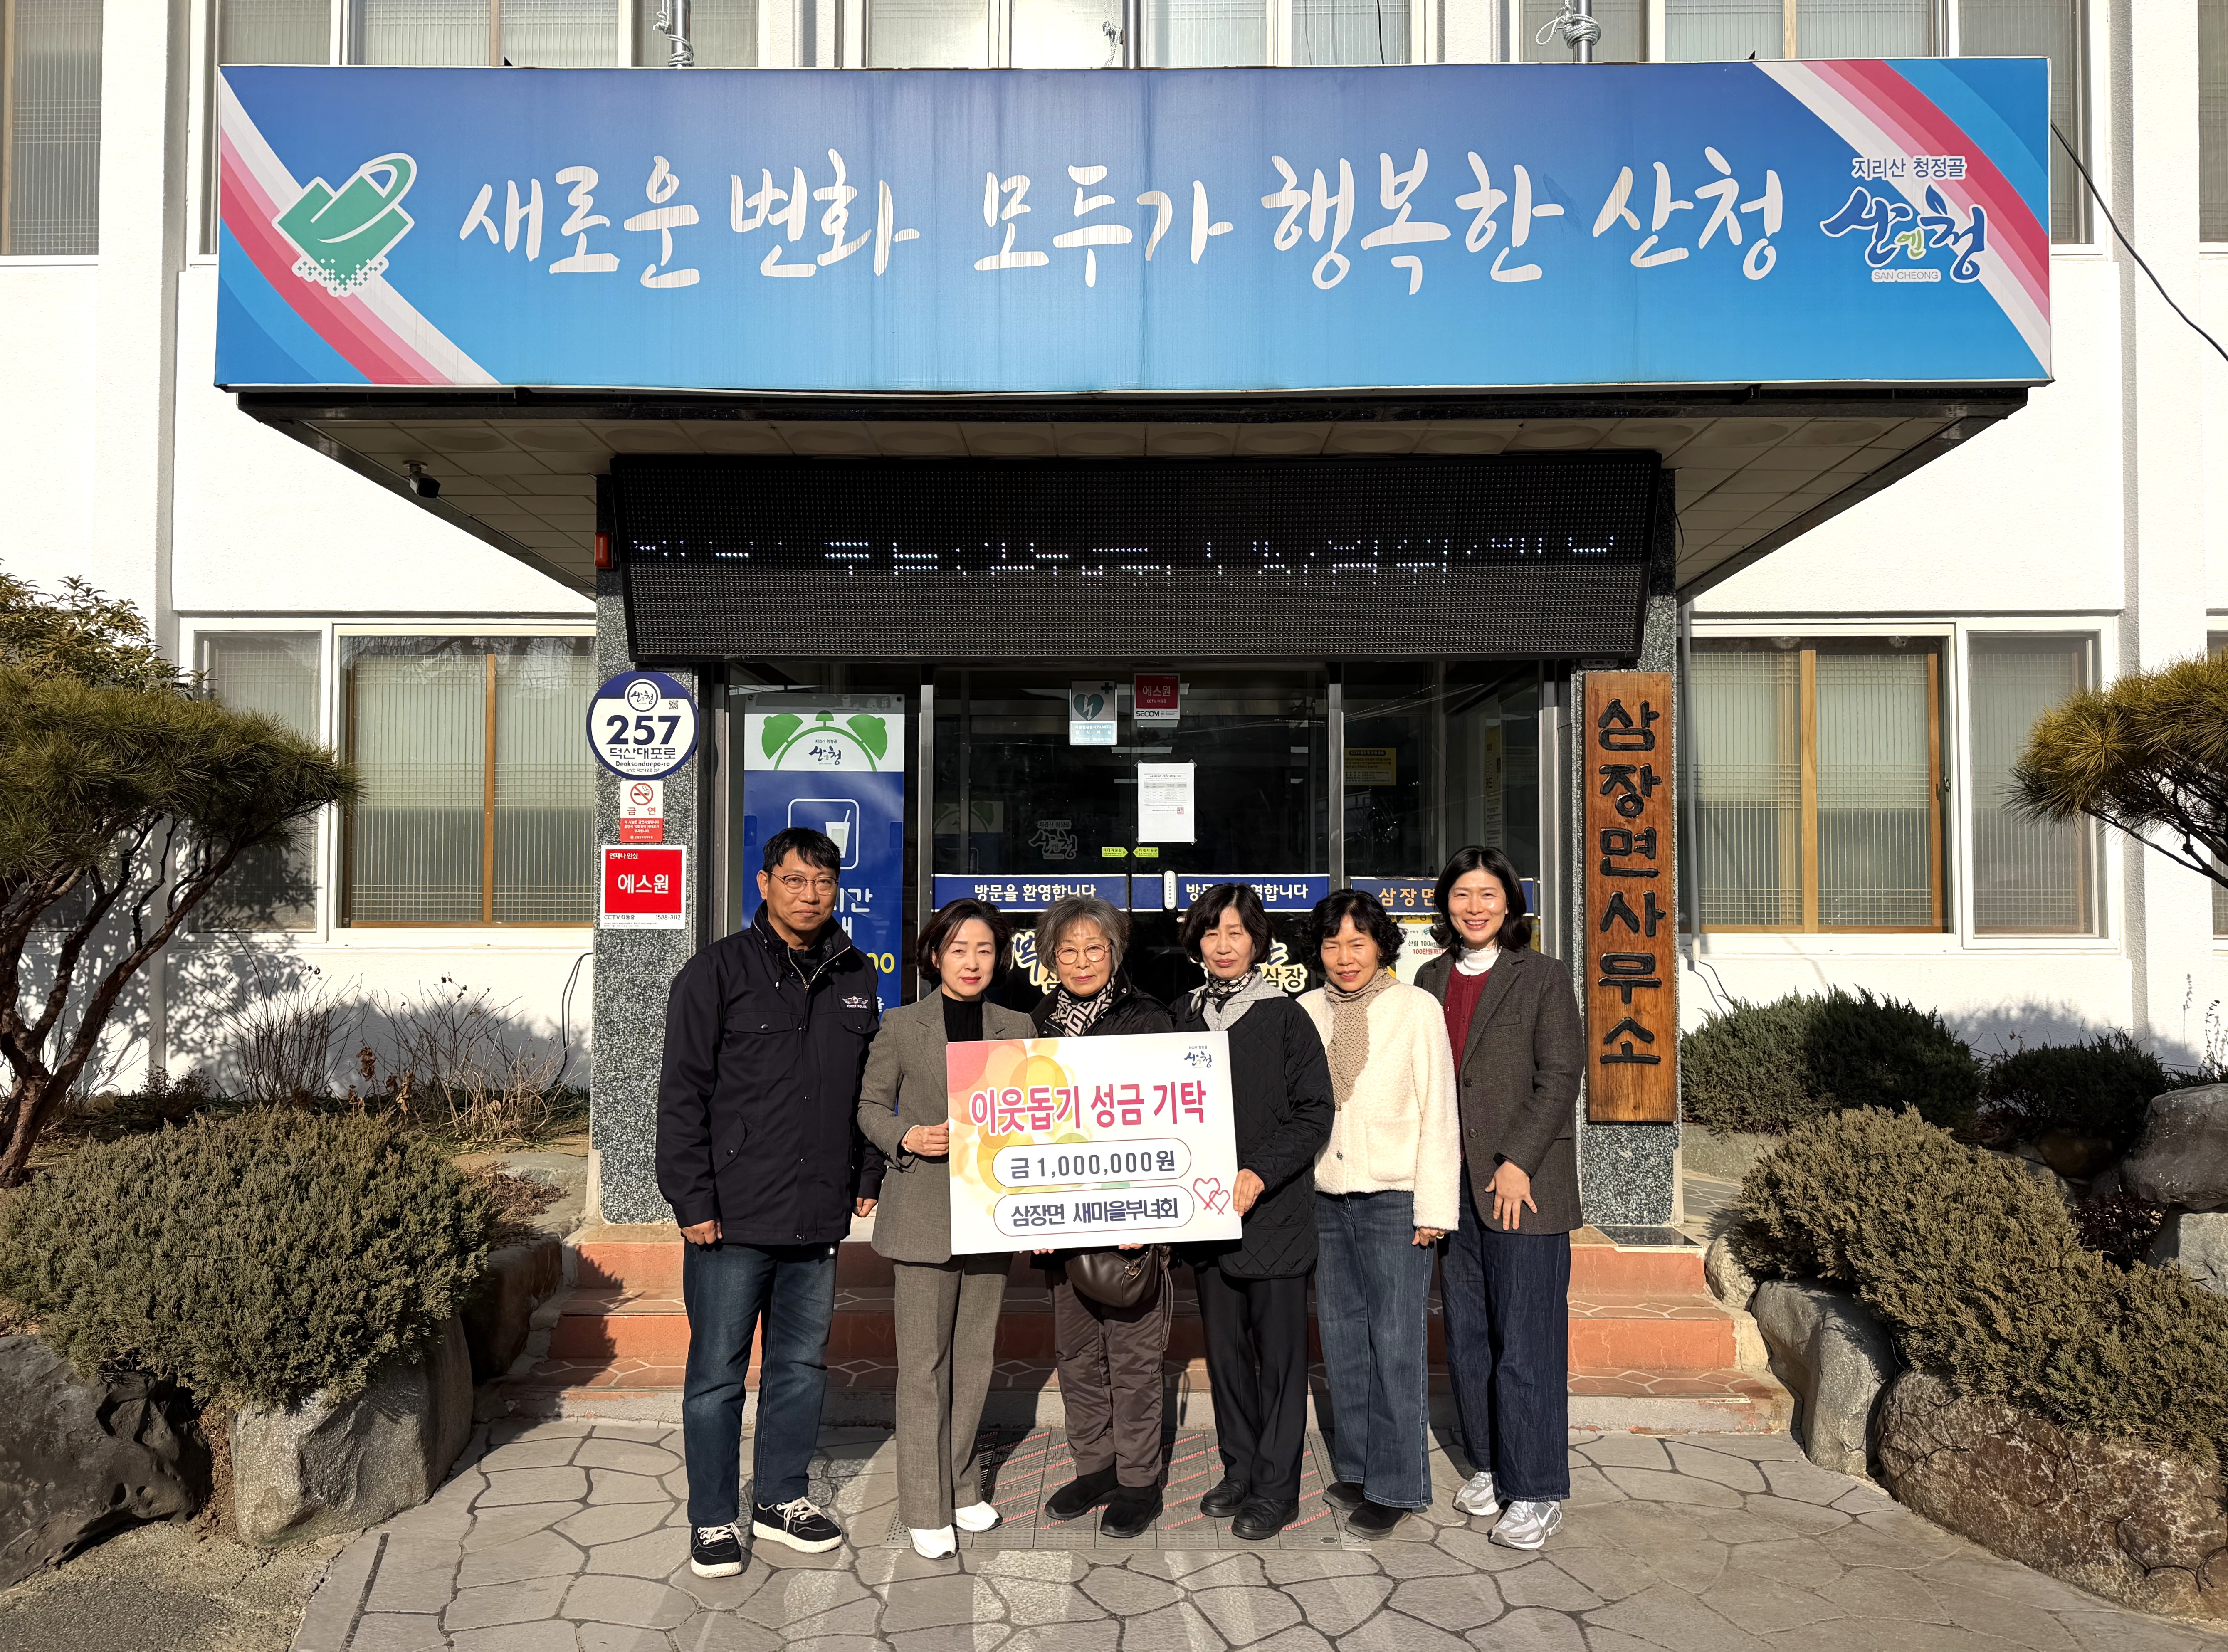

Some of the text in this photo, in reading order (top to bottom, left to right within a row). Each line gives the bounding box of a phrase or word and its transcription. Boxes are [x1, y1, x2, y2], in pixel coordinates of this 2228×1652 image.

[1854, 157, 1965, 178] 지리산 청정골
[459, 146, 1783, 295] 새로운 변화 모두가 행복한 산청
[1874, 271, 1939, 280] SAN CHEONG
[1142, 686, 1171, 697] 에스원
[605, 714, 681, 746] 257
[610, 748, 676, 759] 덕산대포로
[618, 874, 669, 894] 에스원
[1598, 698, 1665, 1064] 삼장면사무소
[975, 884, 1096, 902] 방문을 환영합니다
[1263, 968, 1304, 989] 삼장
[971, 1080, 1206, 1133] 이웃돕기 성금 기탁
[1010, 1150, 1175, 1179] 금 1,000,000원
[1011, 1197, 1178, 1227] 삼장면 새마을부녀회
